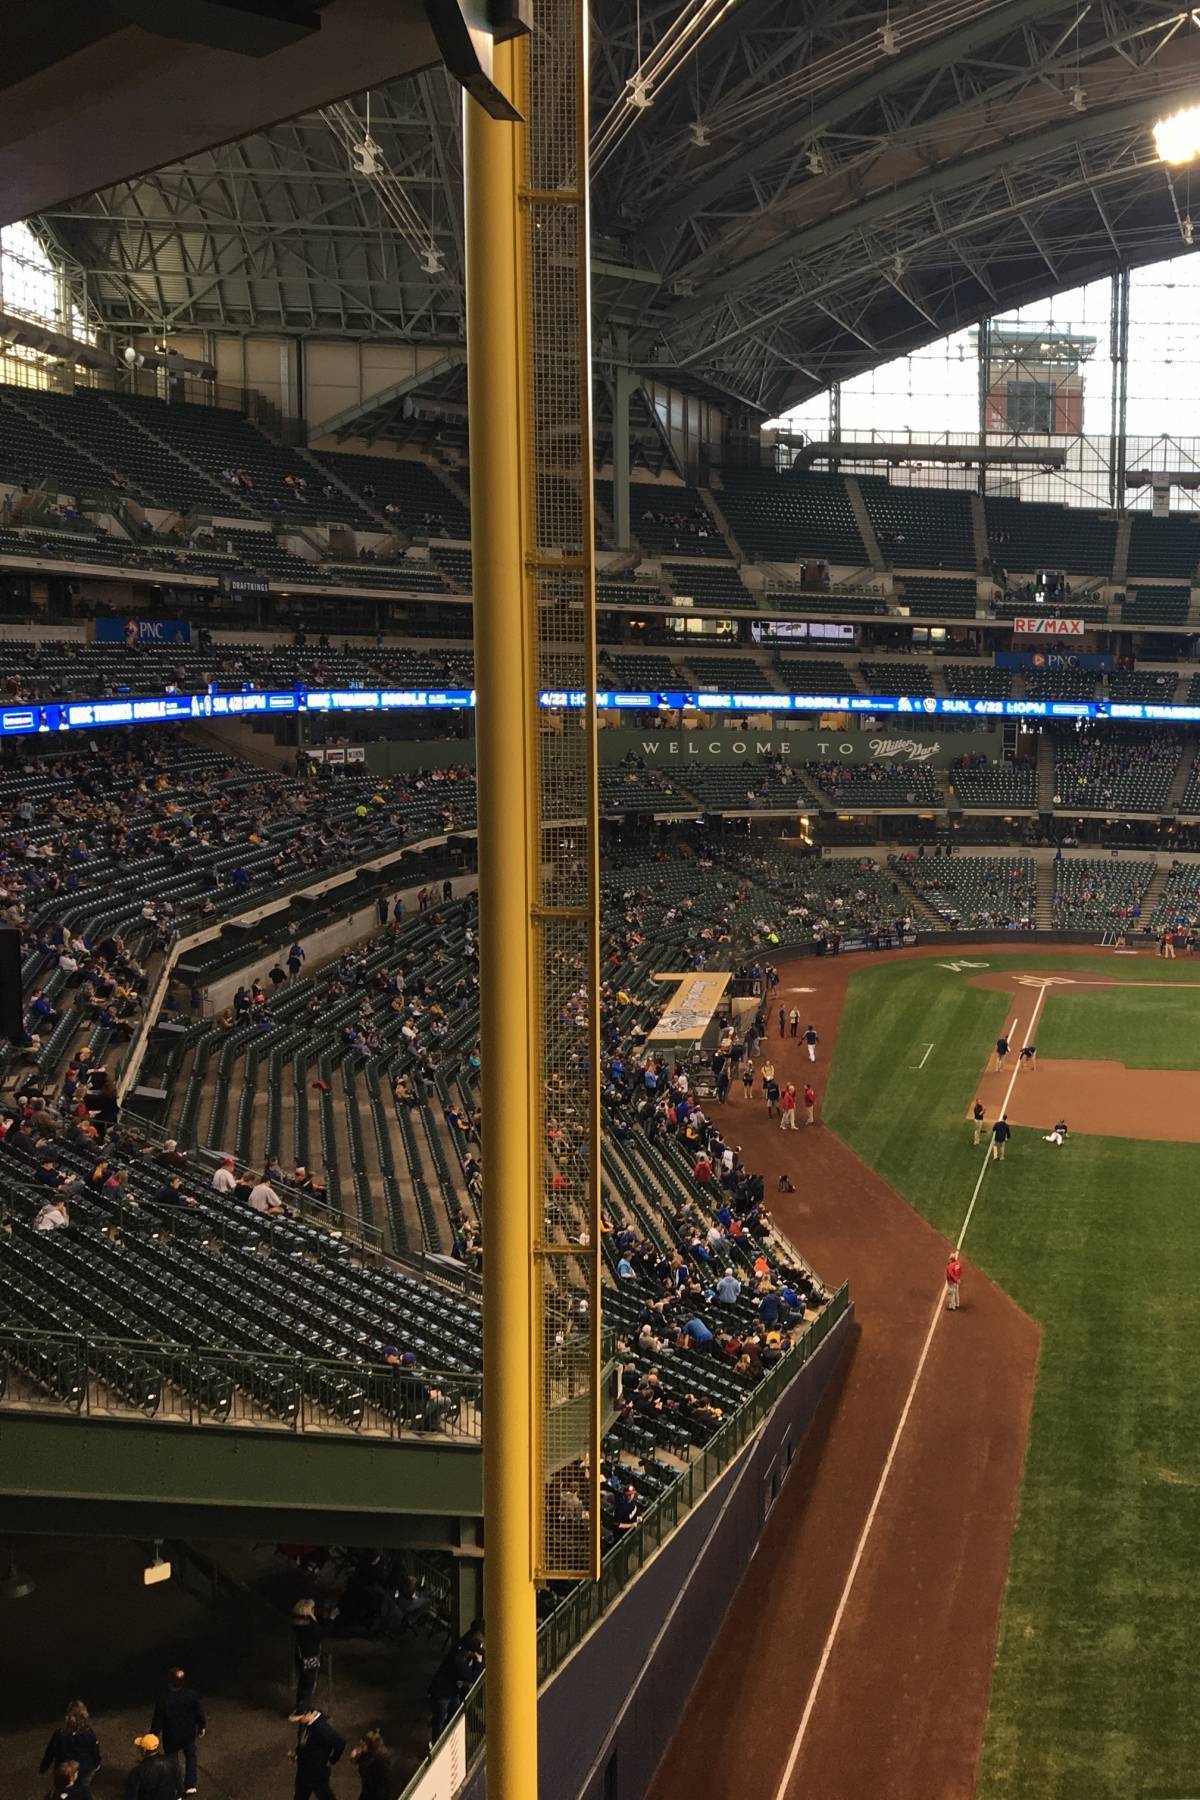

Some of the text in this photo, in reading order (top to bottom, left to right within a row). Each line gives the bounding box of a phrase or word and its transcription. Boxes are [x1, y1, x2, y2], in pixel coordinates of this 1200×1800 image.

[232, 581, 268, 592] DRAFTKINGS
[139, 622, 164, 639] PNC
[1015, 619, 1081, 633] RE/MAX
[1048, 655, 1079, 667] PNC
[942, 701, 972, 714] SUN,
[642, 739, 941, 760] WELCOME TO Miller Park
